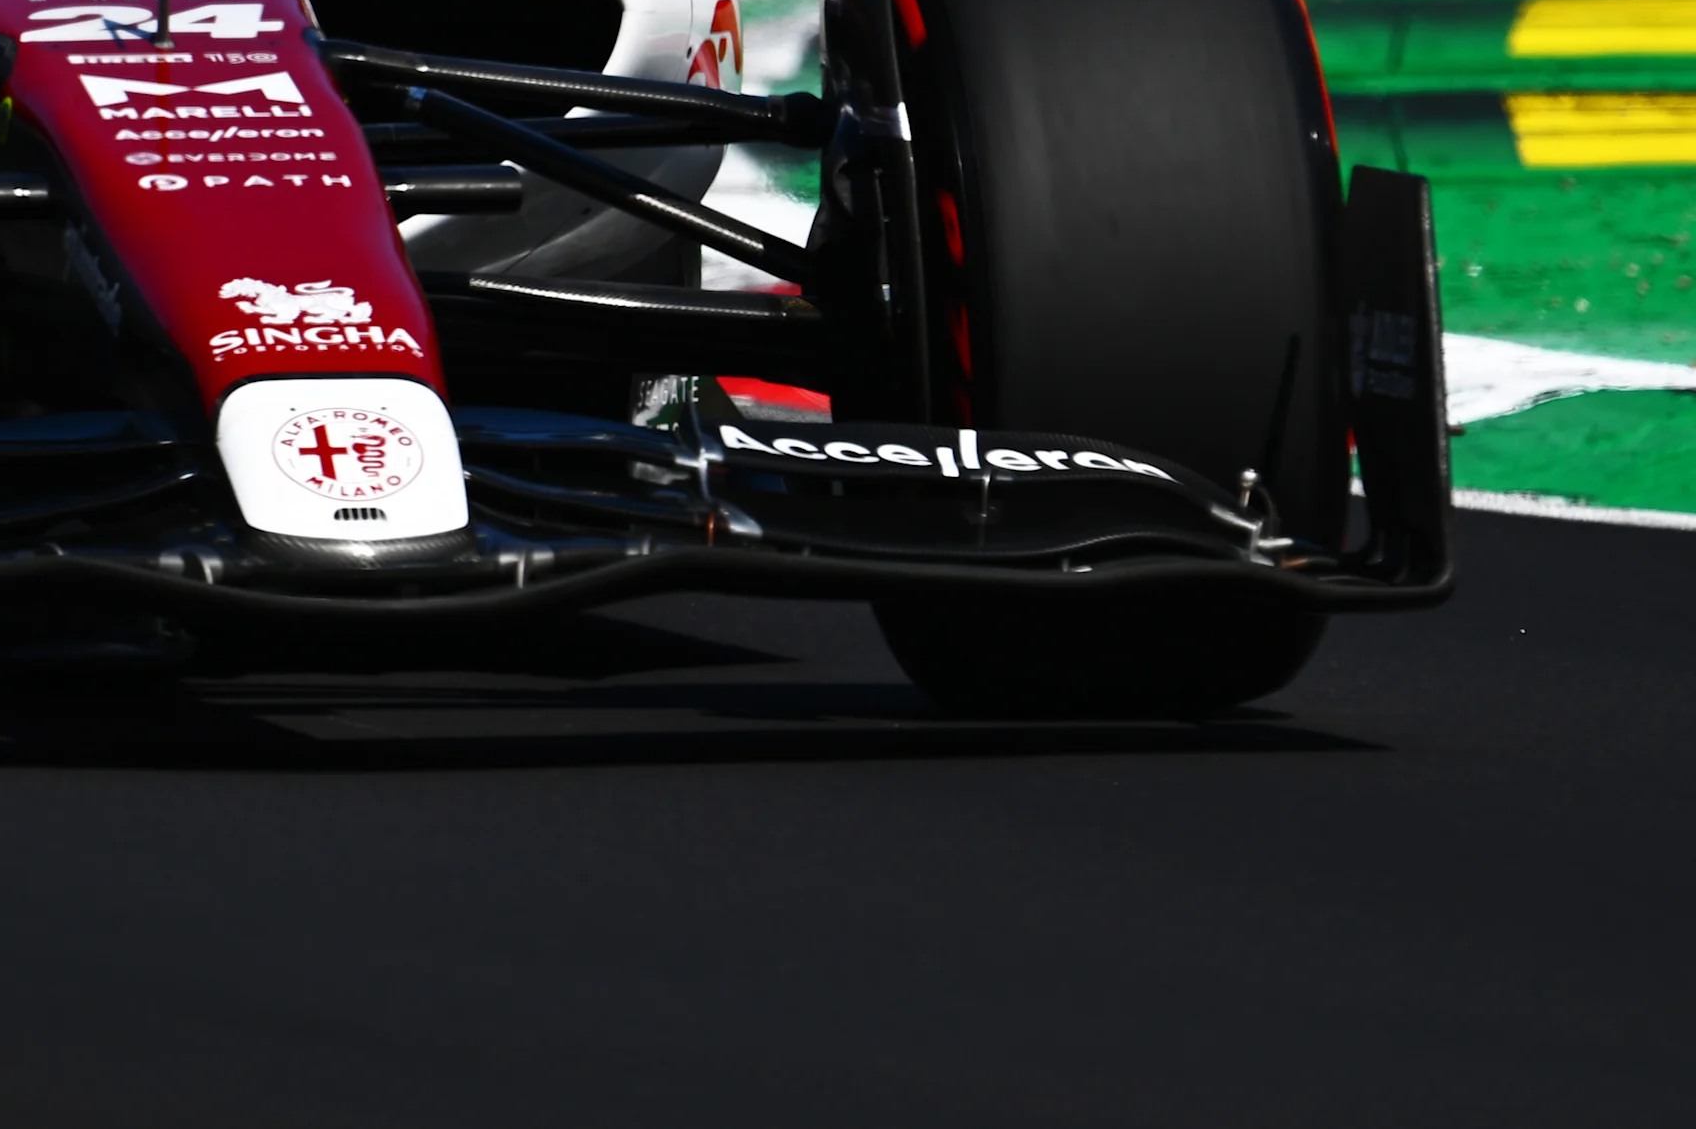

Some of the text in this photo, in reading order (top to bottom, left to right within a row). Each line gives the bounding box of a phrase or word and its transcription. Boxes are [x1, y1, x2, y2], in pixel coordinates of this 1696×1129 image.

[19, 2, 285, 43] 24
[98, 105, 314, 120] MARELLI
[115, 125, 325, 143] Accelleron
[202, 174, 353, 188] PATH
[208, 326, 423, 355] SINGHA
[306, 475, 402, 498] MILANO
